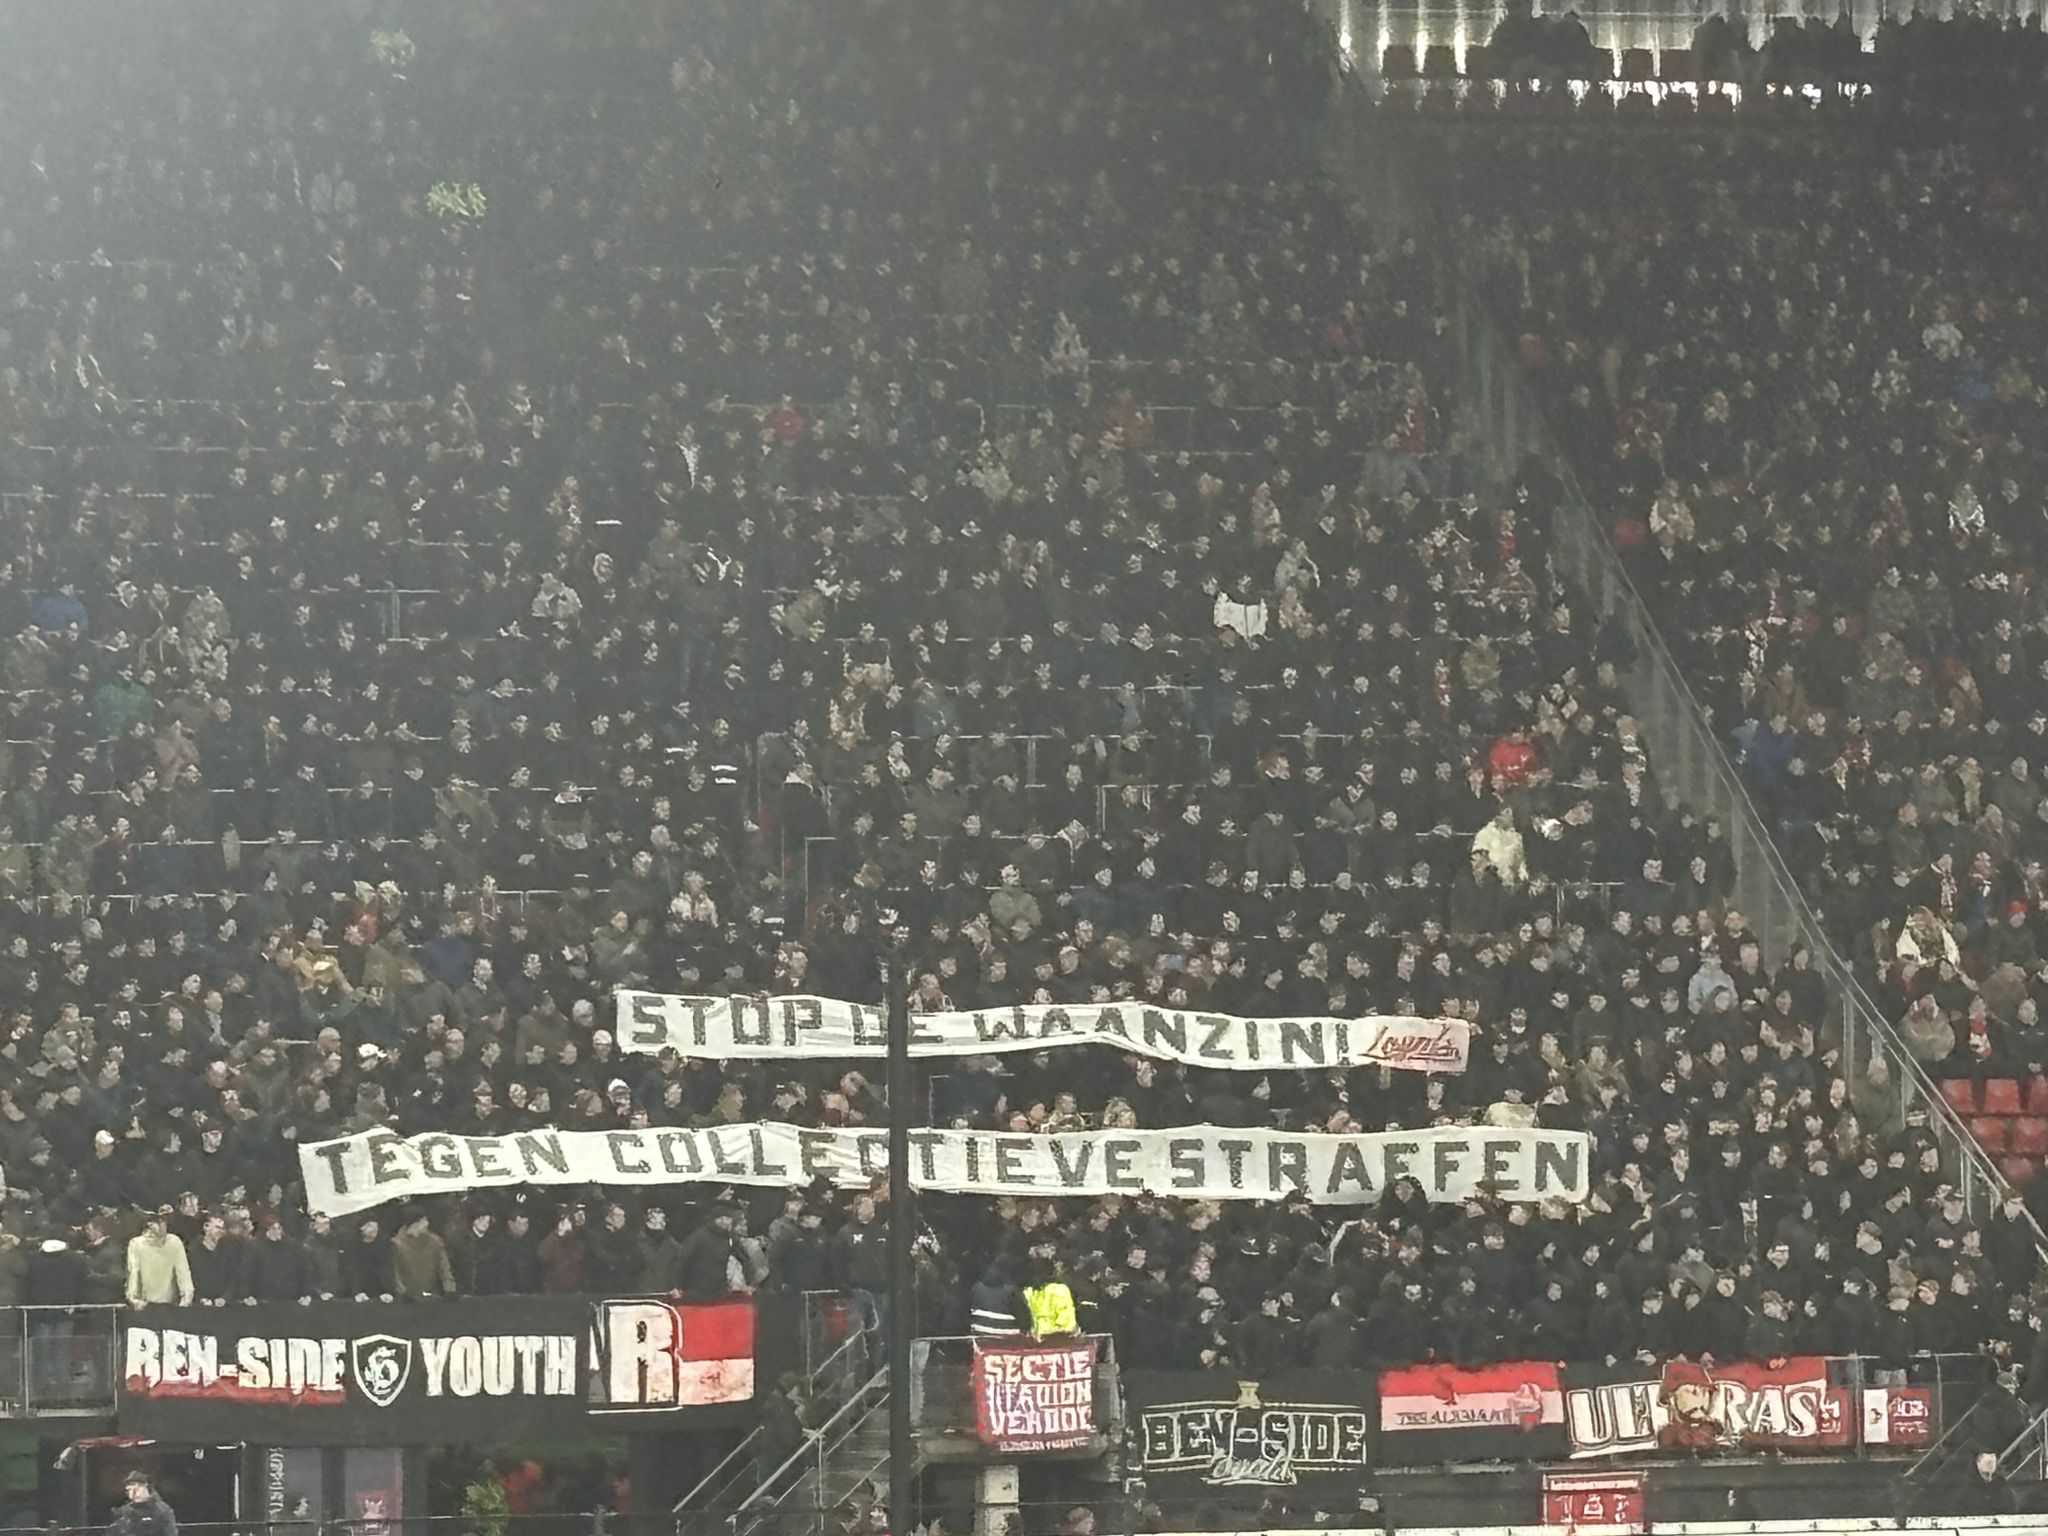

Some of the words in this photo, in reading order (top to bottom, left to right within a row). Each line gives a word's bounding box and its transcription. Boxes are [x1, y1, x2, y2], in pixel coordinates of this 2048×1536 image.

[631, 995, 823, 1046] STOP
[851, 1004, 944, 1046] DE
[973, 1006, 1351, 1066] WAANZIN!
[316, 1133, 571, 1194] TEGEN
[607, 1129, 1143, 1188] COLLECTIEVE
[1170, 1139, 1581, 1193] STRAFFEN
[419, 1335, 577, 1397] YOUTH
[983, 1350, 1092, 1383] SECTIE
